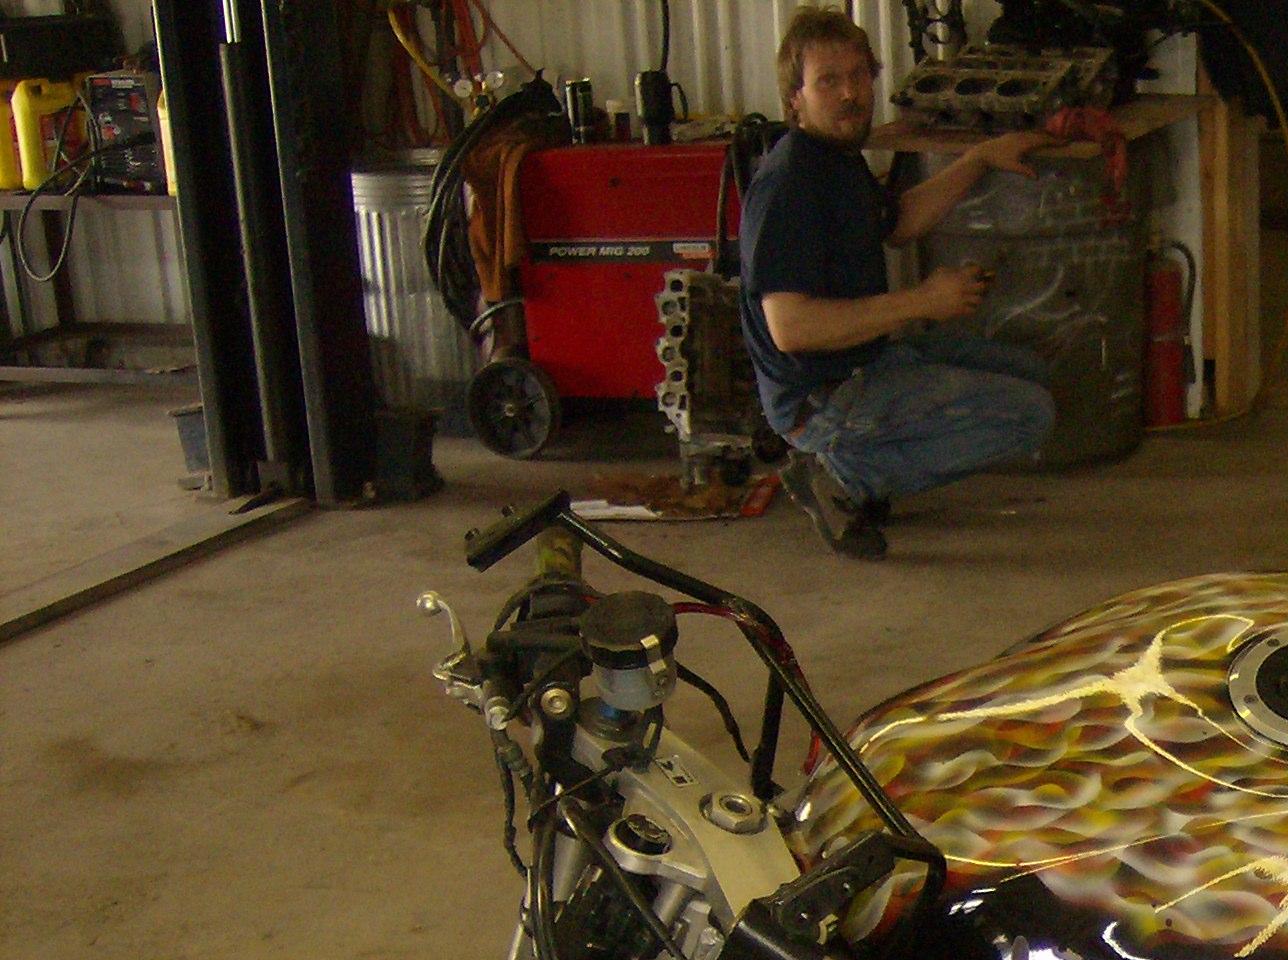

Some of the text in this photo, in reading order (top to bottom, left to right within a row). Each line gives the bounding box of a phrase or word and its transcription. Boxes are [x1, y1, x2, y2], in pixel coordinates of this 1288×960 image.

[549, 246, 651, 257] POWER MIG 200
